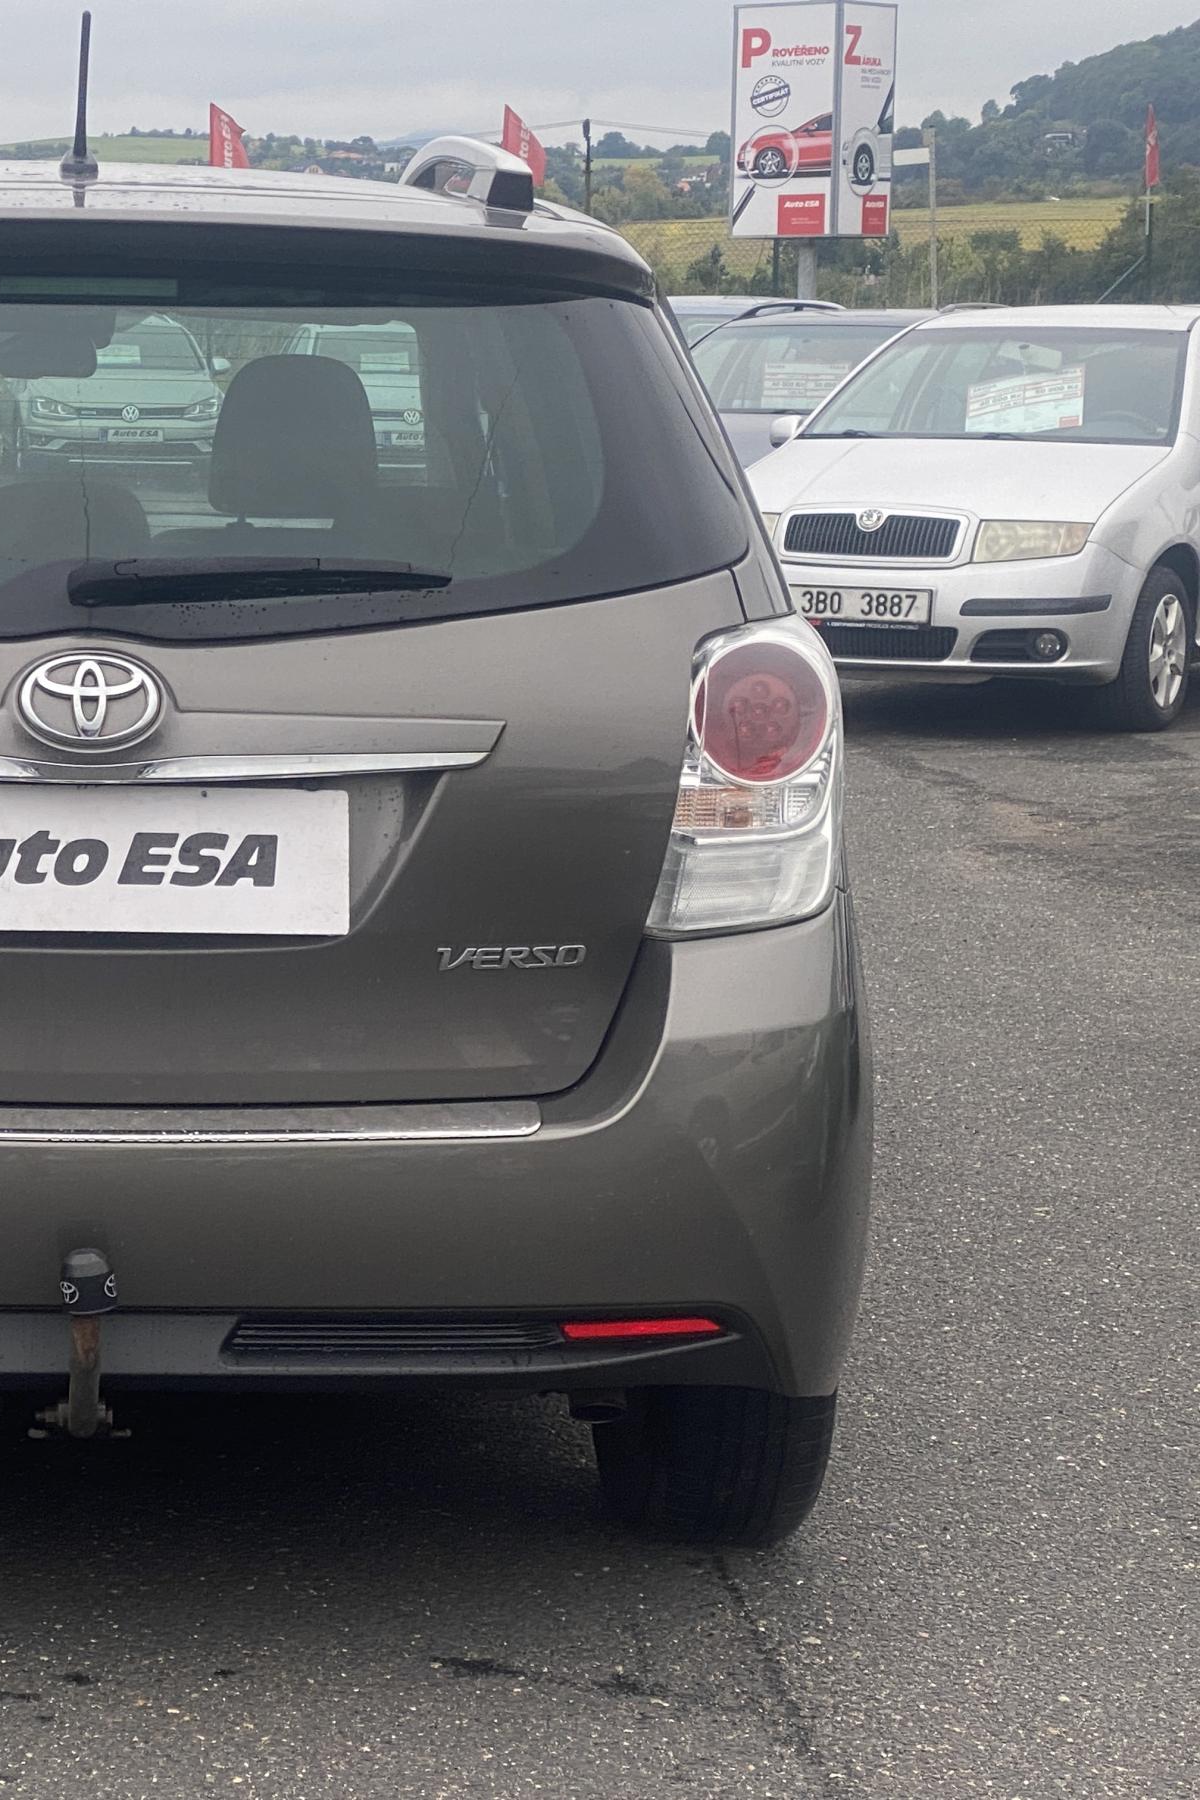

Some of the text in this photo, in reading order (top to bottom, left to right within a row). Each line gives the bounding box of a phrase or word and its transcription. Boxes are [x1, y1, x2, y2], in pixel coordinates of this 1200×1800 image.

[805, 58, 825, 66] VOZY
[224, 141, 232, 168] uto
[784, 200, 803, 208] Auto
[860, 592, 918, 618] 3887
[117, 831, 279, 888] ESA
[436, 944, 587, 971] VERSO
